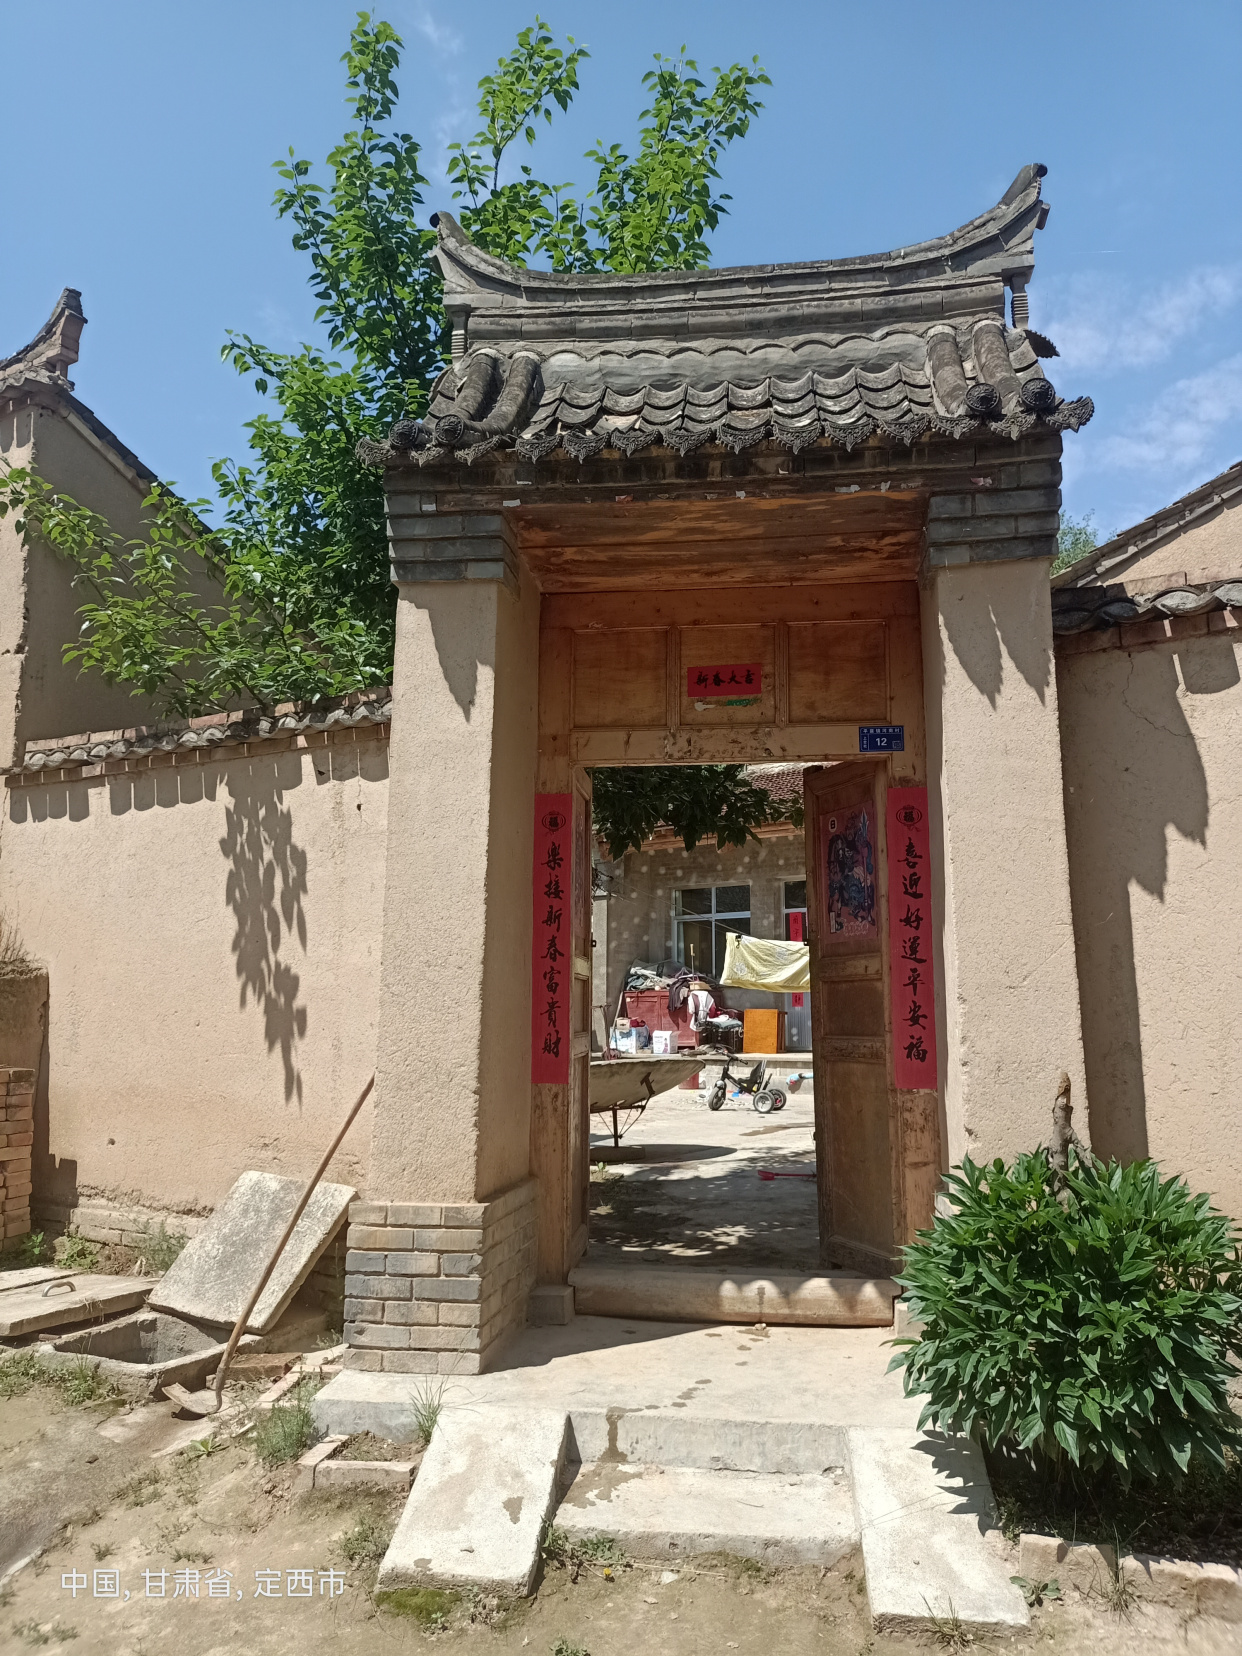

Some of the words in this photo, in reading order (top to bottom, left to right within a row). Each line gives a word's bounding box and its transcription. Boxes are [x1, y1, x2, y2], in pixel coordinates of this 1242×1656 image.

[693, 669, 755, 688] 新春大吉
[875, 737, 888, 746] 12
